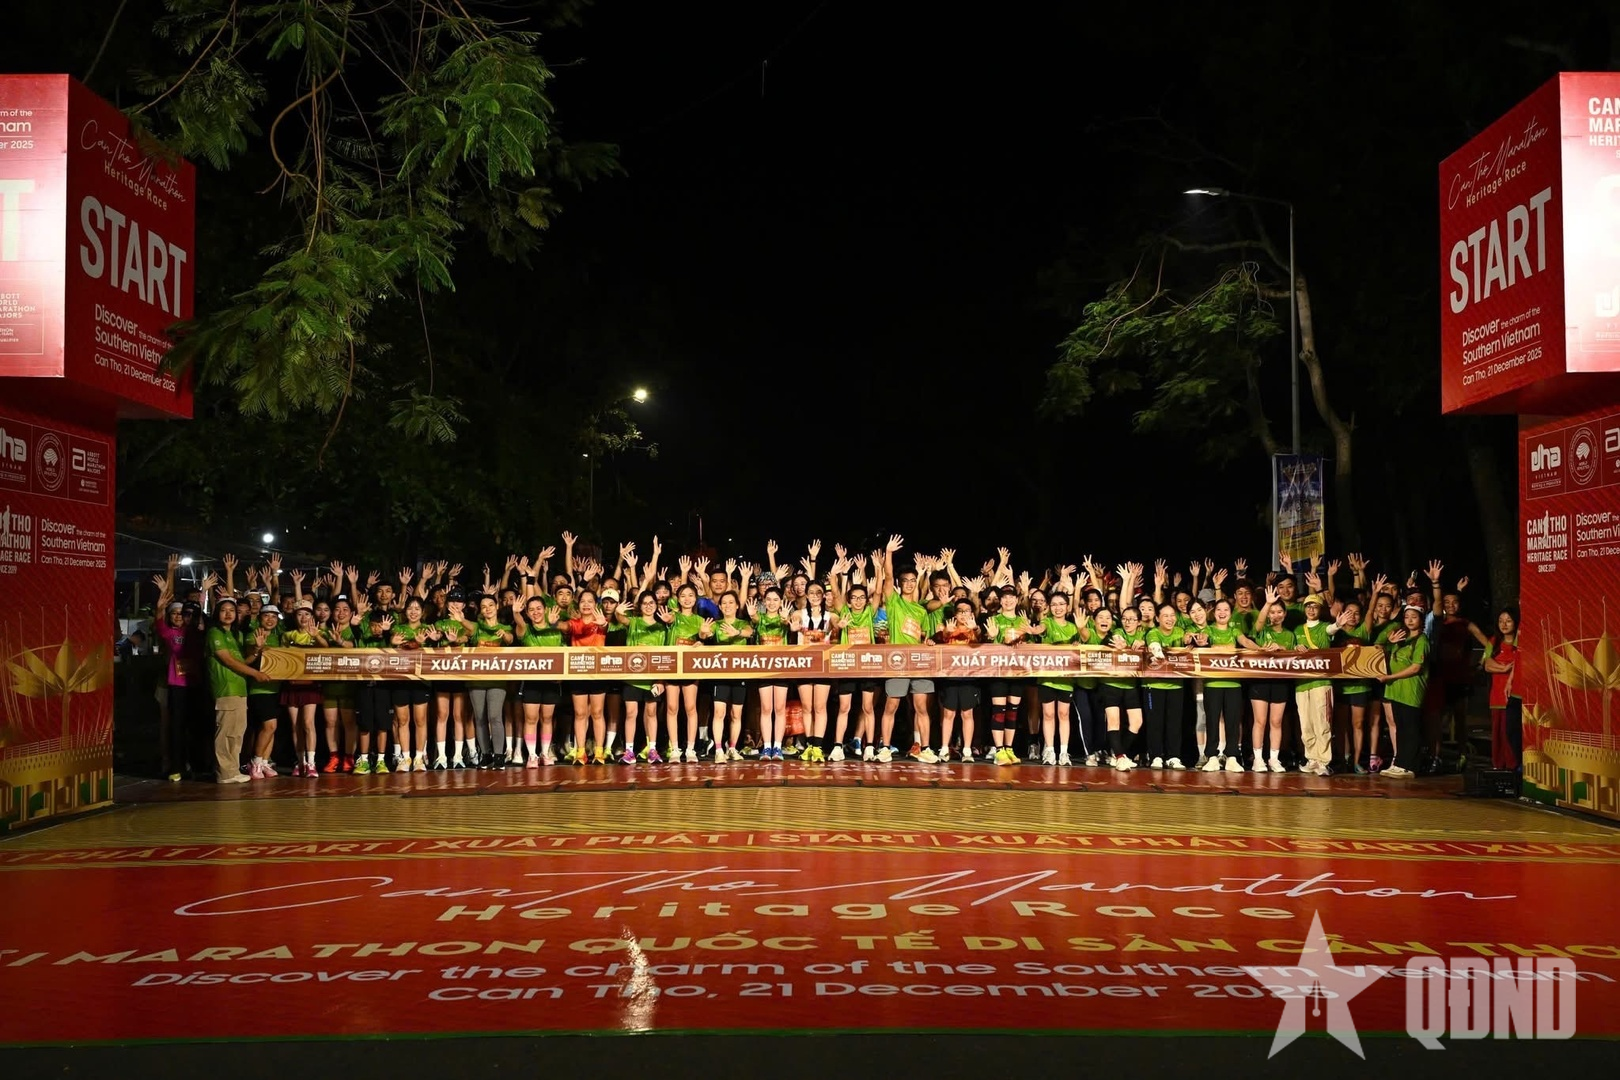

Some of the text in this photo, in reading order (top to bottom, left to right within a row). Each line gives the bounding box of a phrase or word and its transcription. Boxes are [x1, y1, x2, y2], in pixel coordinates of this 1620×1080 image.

[10, 109, 19, 117] of
[19, 109, 33, 117] the
[11, 140, 34, 149] 2025
[1486, 115, 1549, 179] Marathon
[104, 160, 168, 211] Heritage Race
[1466, 160, 1527, 208] Heritage Race
[80, 195, 187, 318] START
[1450, 186, 1552, 314] START
[95, 303, 139, 336] Discover
[1462, 318, 1500, 347] Discover
[1509, 314, 1526, 327] charm
[95, 325, 139, 357] Southern
[1462, 322, 1541, 366] Southern Vietnam
[95, 353, 109, 367] Can
[124, 363, 130, 375] 21
[131, 366, 161, 387] December
[162, 379, 176, 392] 2025
[1462, 373, 1475, 386] Can
[1487, 364, 1493, 376] 21
[1494, 354, 1527, 373] December
[1527, 346, 1542, 362] 2025
[12, 513, 32, 533] THO
[41, 518, 76, 534] Discover
[1527, 514, 1567, 536] CAN THO
[1576, 511, 1611, 527] Discover
[41, 535, 105, 553] Southern Vietnam
[1527, 533, 1568, 551] MARATHON
[1577, 528, 1612, 542] Southern
[15, 551, 32, 563] RACE
[41, 555, 52, 564] Can
[70, 557, 95, 567] December
[95, 560, 106, 568] 2025
[1527, 549, 1568, 563] HERITAGE RACE
[1577, 549, 1587, 558] Can
[431, 654, 468, 671] XUẤT
[472, 656, 554, 672] PHÁT/START
[692, 653, 728, 669] XUẤT
[732, 654, 813, 670] PHÁT/START
[951, 651, 987, 667] XUẤT
[990, 652, 1071, 668] PHÁT/START
[1209, 655, 1245, 669] XUẤT
[1249, 656, 1331, 671] PHÁT/START
[226, 842, 393, 856] START
[584, 833, 729, 846] PHÁT
[769, 833, 922, 844] START
[1108, 836, 1250, 849] PHÁT
[1296, 838, 1445, 853] START
[174, 866, 1517, 916] Can Tho Marathon
[435, 900, 1295, 921] Heritage Race
[568, 929, 819, 955] QUỐC
[841, 929, 940, 950] TẾ
[963, 936, 1045, 951] DI
[1067, 933, 1239, 953] SẢN
[131, 960, 1616, 987] Discover the charm of the Southern Vietnam
[428, 986, 564, 1001] Can
[739, 982, 793, 998] 21
[815, 982, 1168, 998] December
[1185, 982, 1341, 1000] 2025
